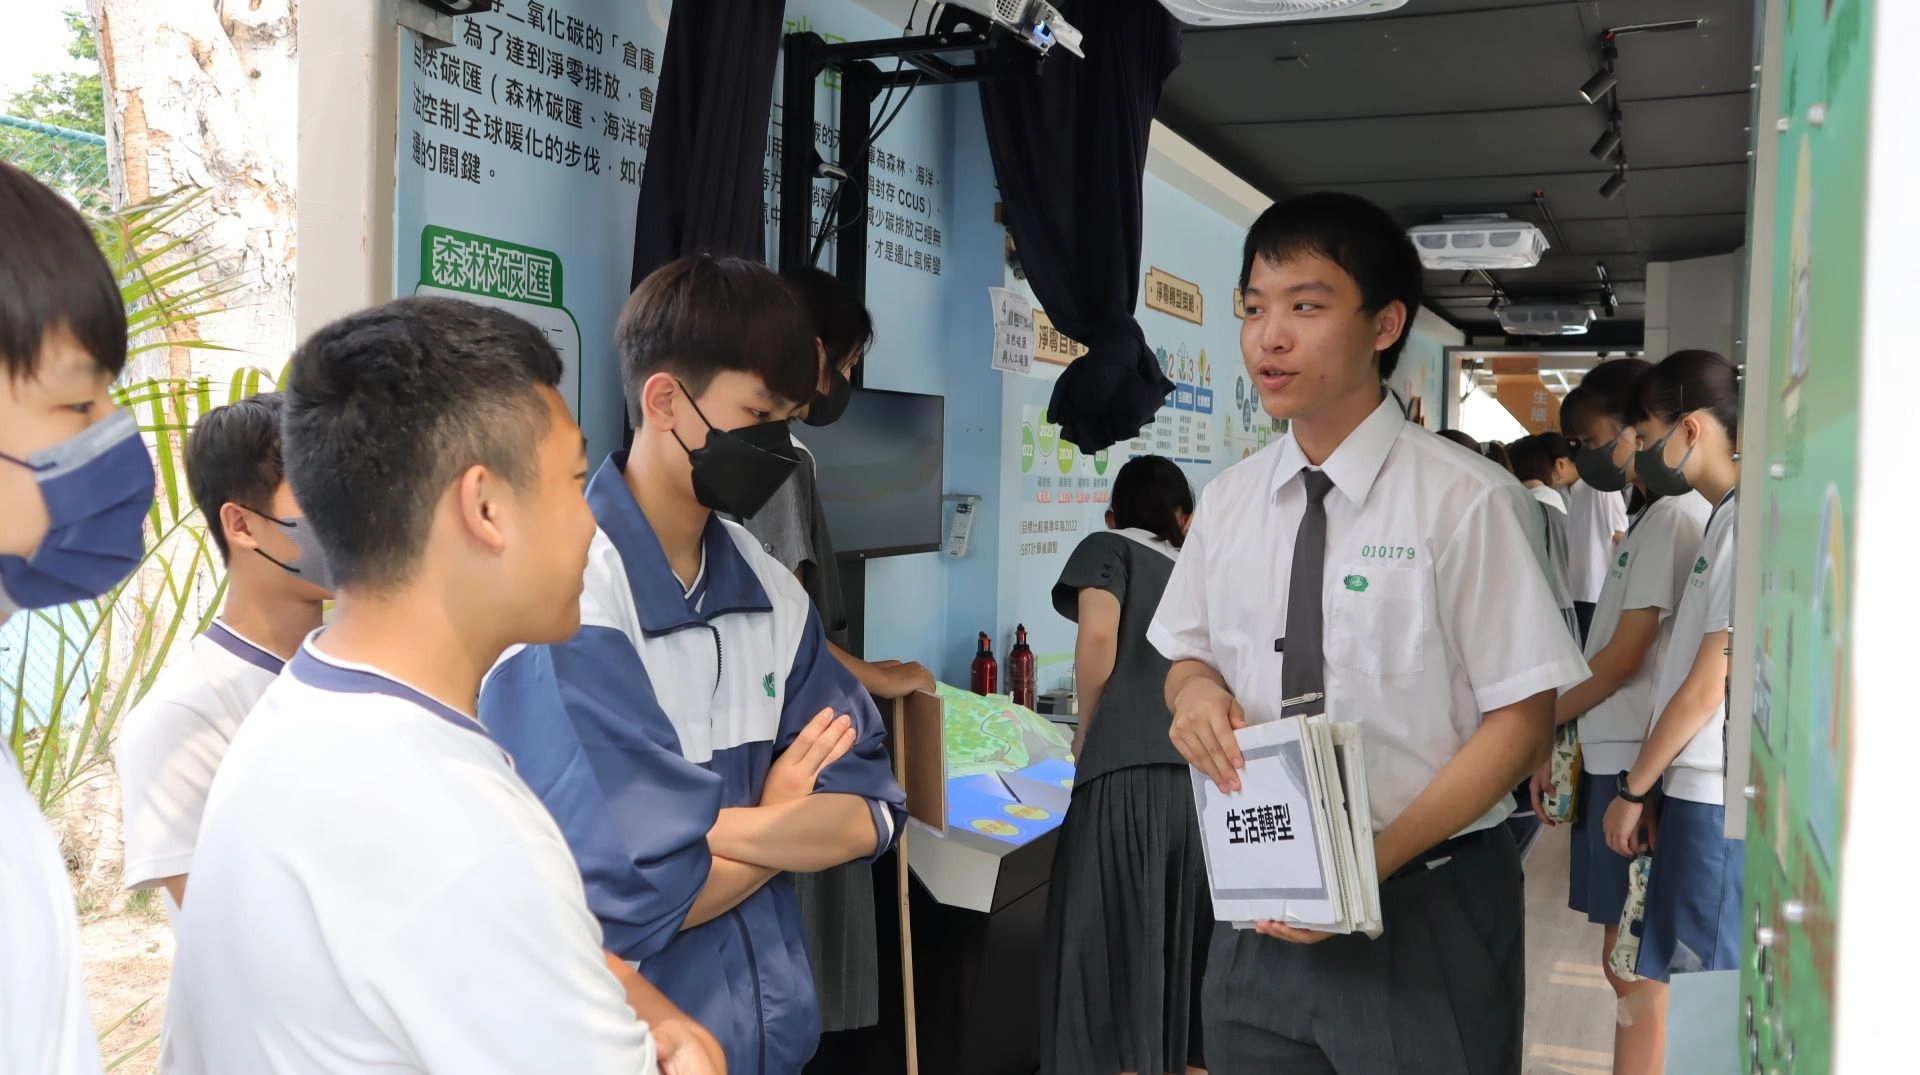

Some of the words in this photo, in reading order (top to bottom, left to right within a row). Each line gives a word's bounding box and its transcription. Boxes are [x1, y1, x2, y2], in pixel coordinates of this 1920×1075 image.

[432, 234, 553, 303] 森林碳匯
[1168, 353, 1175, 379] 2
[1188, 359, 1194, 383] 3
[1205, 364, 1211, 386] 4
[1040, 425, 1054, 438] 2025
[1361, 544, 1416, 560] 010179
[1226, 803, 1295, 845] 生活轉型
